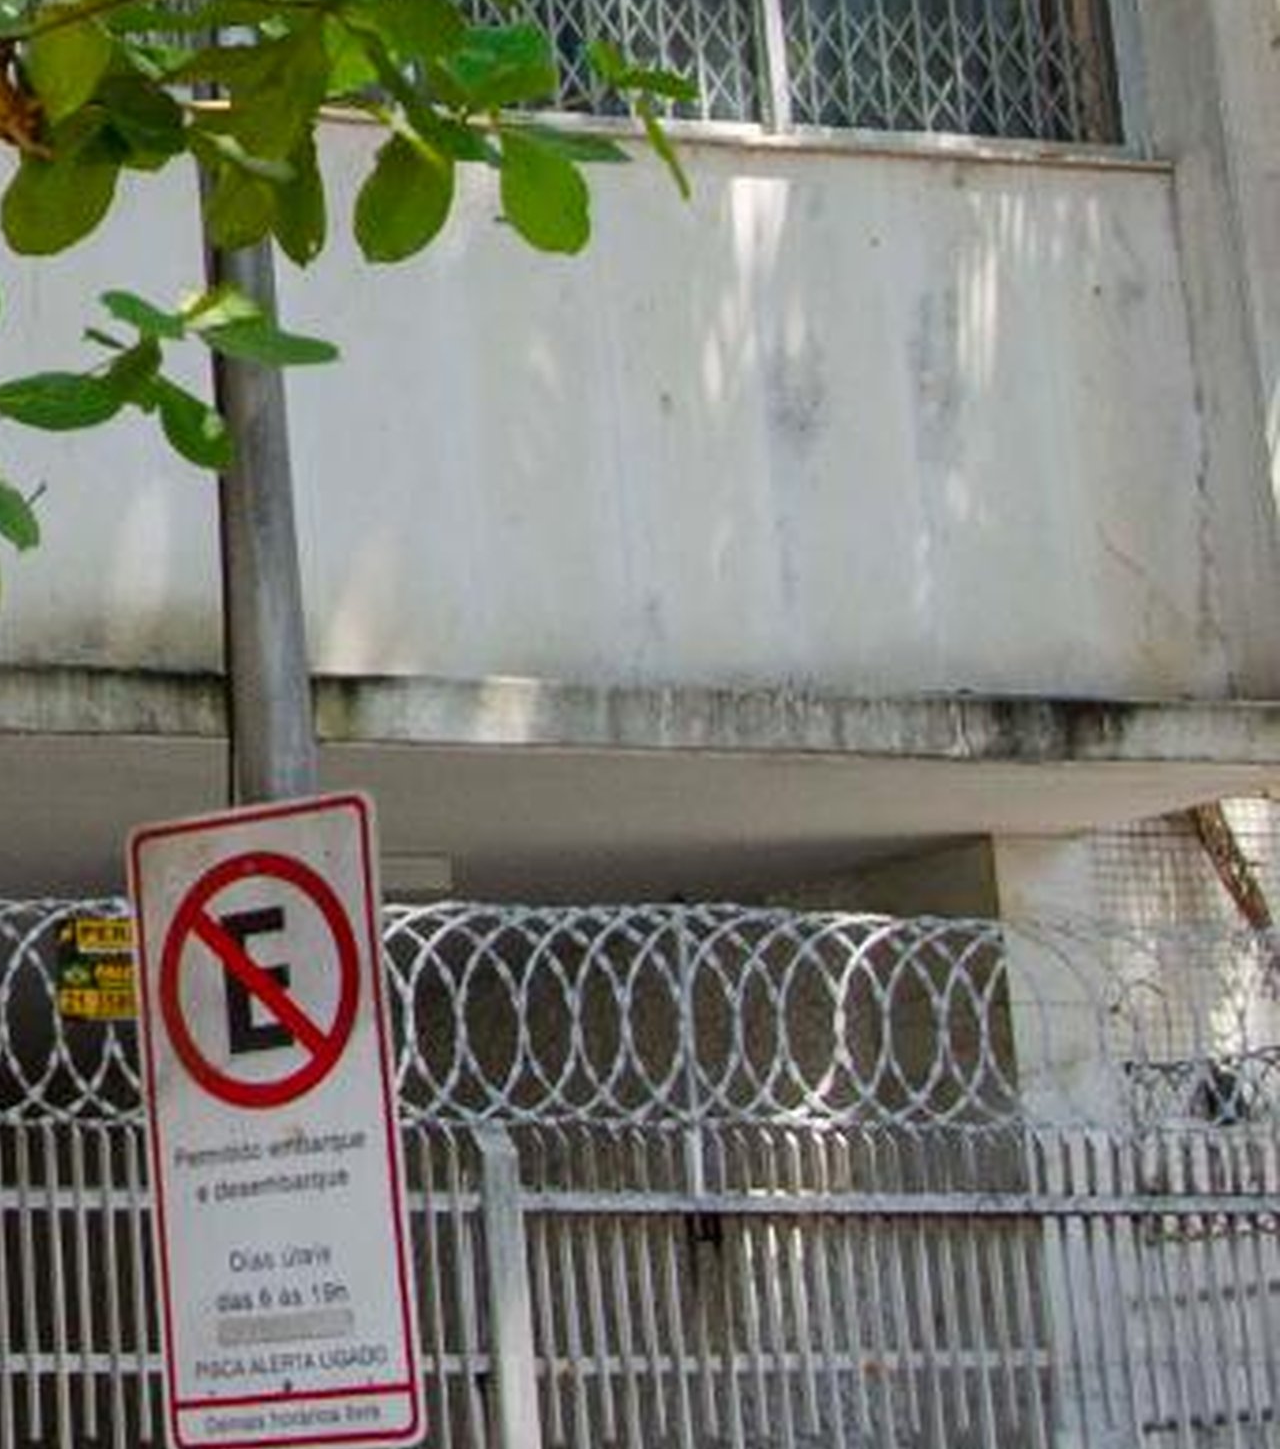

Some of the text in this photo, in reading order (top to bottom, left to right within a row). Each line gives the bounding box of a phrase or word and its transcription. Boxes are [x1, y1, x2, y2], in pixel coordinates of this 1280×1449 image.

[220, 906, 296, 1055] E
[268, 1129, 366, 1159] embarque
[197, 1167, 350, 1204] e desembarque
[228, 1249, 276, 1273] Dias
[250, 1351, 317, 1376] ALERTA
[319, 1343, 389, 1370] LIGADO
